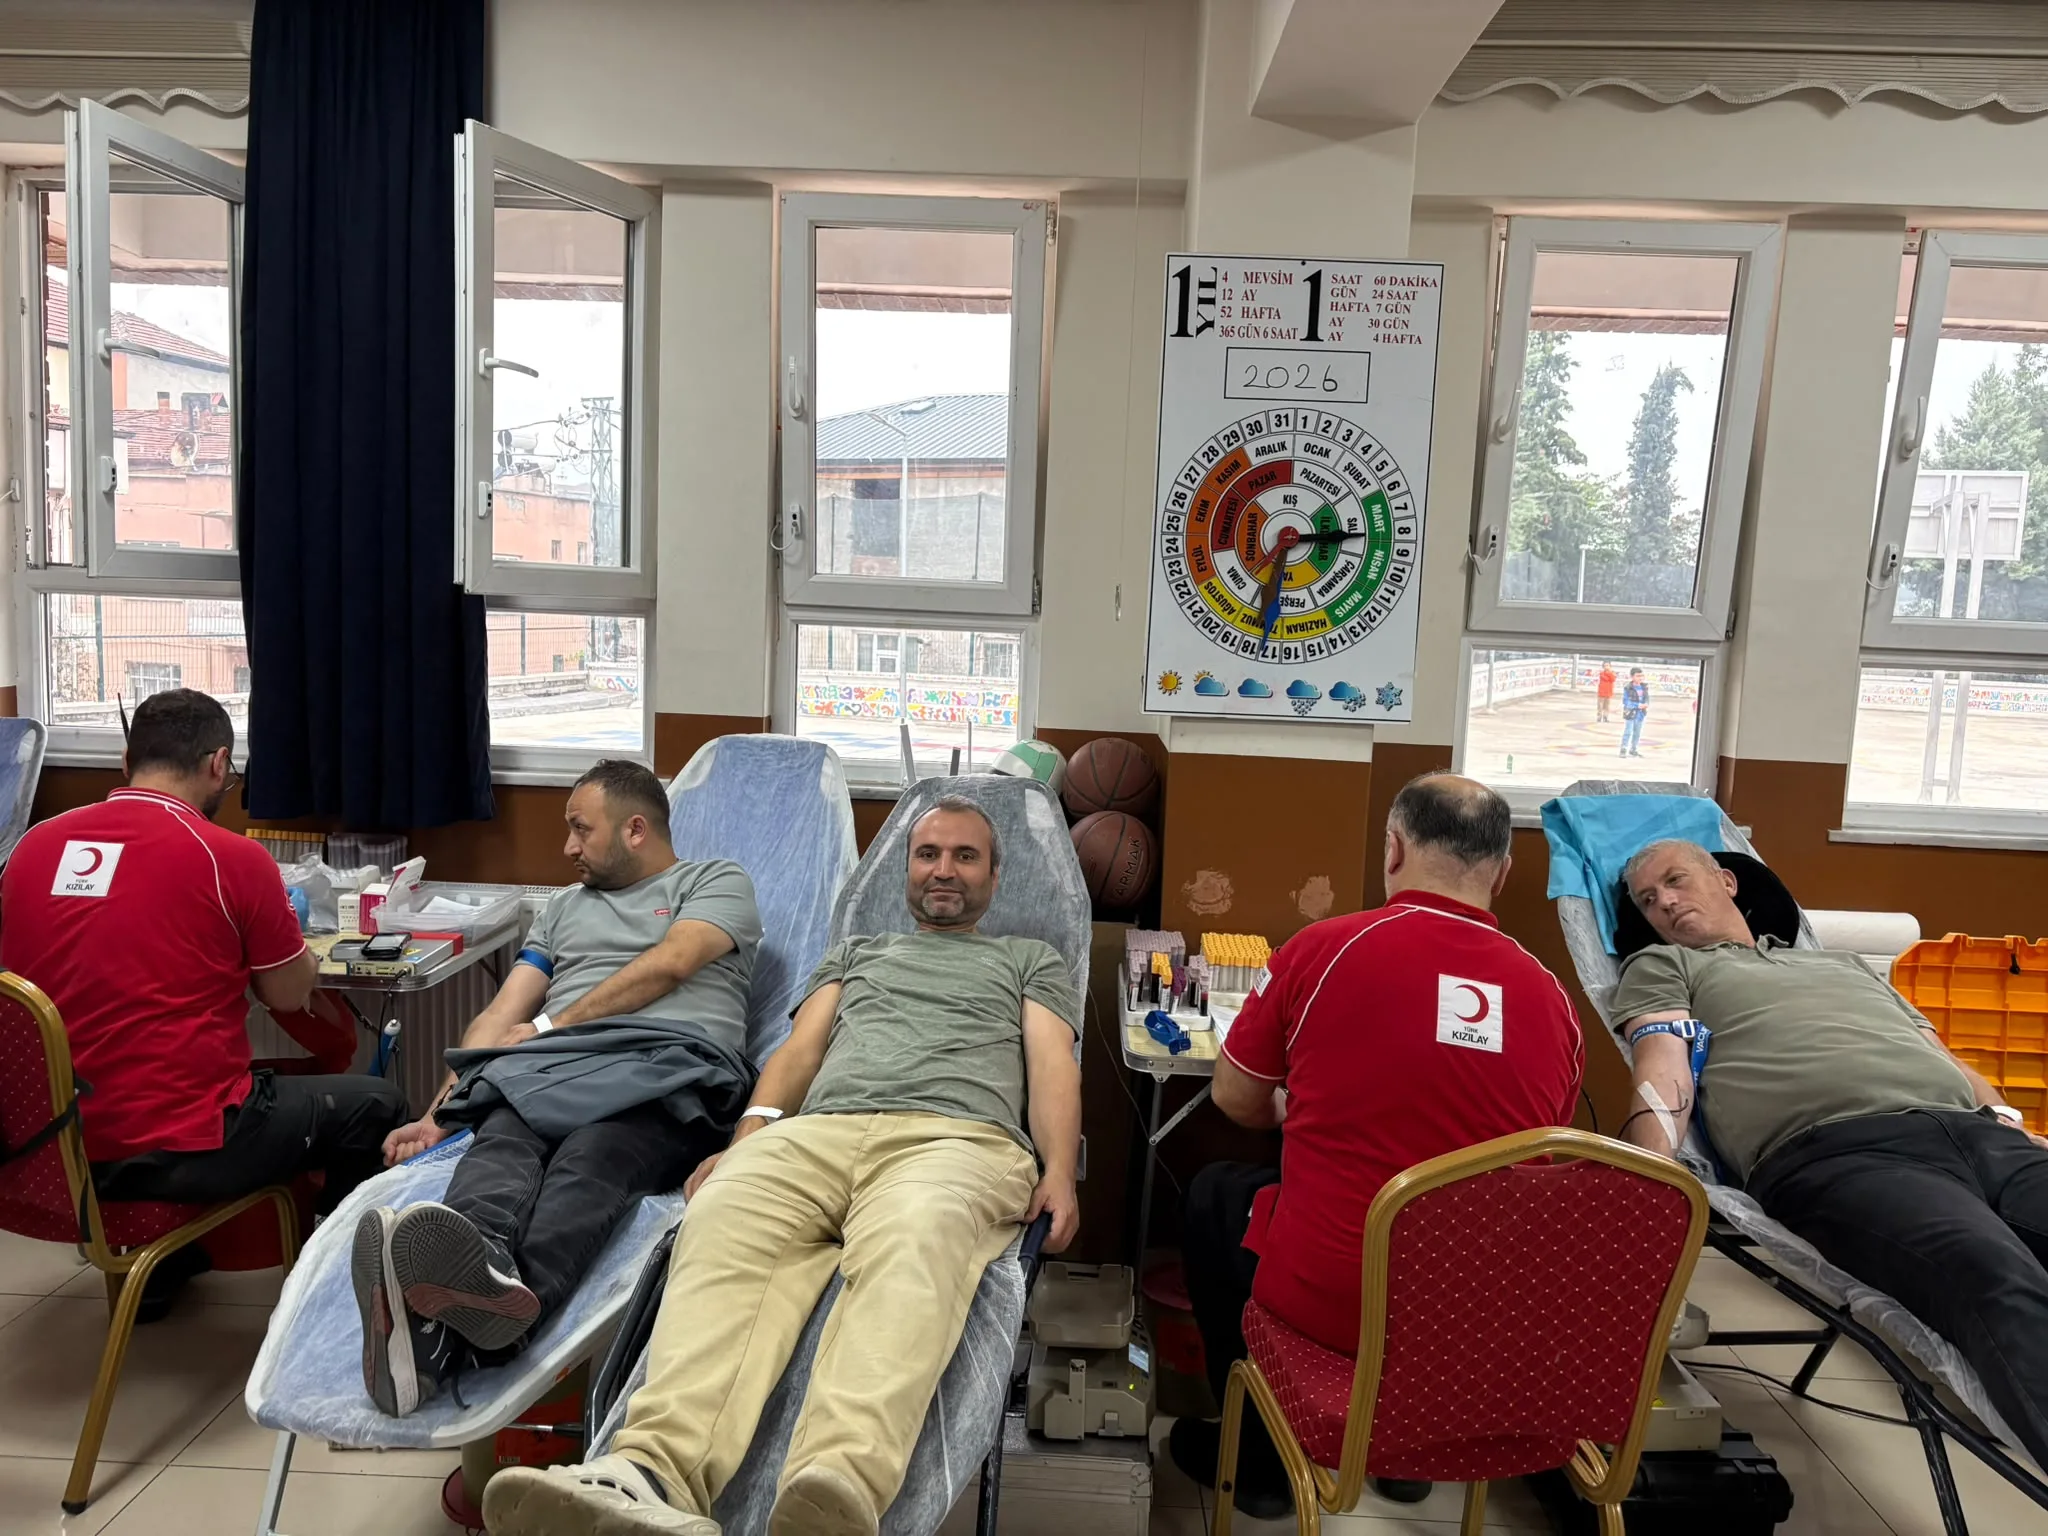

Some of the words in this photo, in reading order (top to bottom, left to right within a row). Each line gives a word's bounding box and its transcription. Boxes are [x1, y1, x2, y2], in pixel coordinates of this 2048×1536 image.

[1222, 272, 1229, 283] 4
[1243, 269, 1293, 285] MEVSİM
[1331, 273, 1363, 285] SAAT
[1374, 275, 1386, 286] 60
[1389, 274, 1438, 288] DAKİKA
[1170, 264, 1194, 338] 1
[1222, 289, 1233, 301] 12
[1241, 289, 1258, 301] AY
[1330, 286, 1357, 299] GÜN
[1372, 289, 1384, 299] 24
[1387, 290, 1418, 301] SAAT
[1195, 266, 1218, 338] YIL
[1300, 268, 1324, 342] 1
[1330, 301, 1370, 313] HAFTA
[1376, 303, 1382, 313] 7
[1385, 301, 1411, 314] GÜN
[1220, 307, 1233, 318] 52
[1241, 307, 1281, 320] HAFTA
[1219, 325, 1236, 338] 365
[1237, 323, 1261, 339] GÜN
[1262, 327, 1269, 339] 6
[1271, 327, 1298, 340] SAAT
[1328, 317, 1345, 327] AY
[1368, 318, 1380, 329] 30
[1383, 317, 1410, 330] GÜN
[1328, 332, 1345, 342] AY
[1373, 334, 1379, 343] 4
[1382, 334, 1423, 345] HAFTA
[1243, 363, 1338, 392] 2026
[1246, 420, 1263, 436] 30
[1274, 413, 1289, 428] 31
[1302, 415, 1308, 429] 1
[1322, 420, 1332, 433] 2
[1223, 430, 1240, 448] 29
[1342, 429, 1353, 442] 3
[1202, 445, 1219, 464] 28
[1255, 441, 1287, 457] ARALIK
[1304, 443, 1331, 458] OCAK
[1361, 444, 1373, 455] 4
[1215, 459, 1241, 485] KASIM
[1375, 460, 1388, 472] 5
[1184, 465, 1200, 485] 27
[1248, 471, 1277, 491] PAZAR
[1300, 467, 1342, 497] PAZARTESİ
[1343, 462, 1371, 490] ŞUBAT
[1387, 480, 1400, 491] 6
[1172, 491, 1187, 509] 26
[1283, 495, 1297, 507] KIŞ
[1394, 502, 1408, 511] 7
[1195, 500, 1210, 522] EKİM
[1371, 504, 1385, 533] MART
[1166, 516, 1180, 531] 25
[1218, 497, 1239, 545] CUMARTESİ
[1347, 517, 1357, 535] SAL
[1246, 512, 1257, 561] SONBAHAR
[1398, 527, 1411, 535] 8
[1166, 537, 1178, 554] 24
[1396, 548, 1409, 557] 9
[1192, 545, 1207, 572] EYLÜL
[1367, 549, 1384, 580] NİSAN
[1168, 560, 1182, 577] 23
[1390, 566, 1405, 583] 10
[1227, 566, 1246, 590] CUMA
[1317, 560, 1355, 597] ÇARŞAMBA
[1175, 580, 1192, 599] 22
[1379, 587, 1396, 603] 11
[1204, 581, 1236, 616] AĞUSTOS
[1280, 594, 1305, 608] PERŞE
[1335, 591, 1363, 617] MAYIS
[1187, 600, 1204, 618] 21
[1364, 605, 1382, 623] 12
[1202, 617, 1220, 634] 20
[1286, 618, 1327, 634] HAZİRAN
[1349, 621, 1367, 638] 13
[1221, 631, 1237, 647] 19
[1329, 633, 1346, 649] 14
[1241, 640, 1256, 655] 18
[1261, 645, 1277, 659] 17
[1284, 646, 1300, 660] 16
[1307, 642, 1324, 657] 15
[1452, 1031, 1488, 1044] KIZILAY
